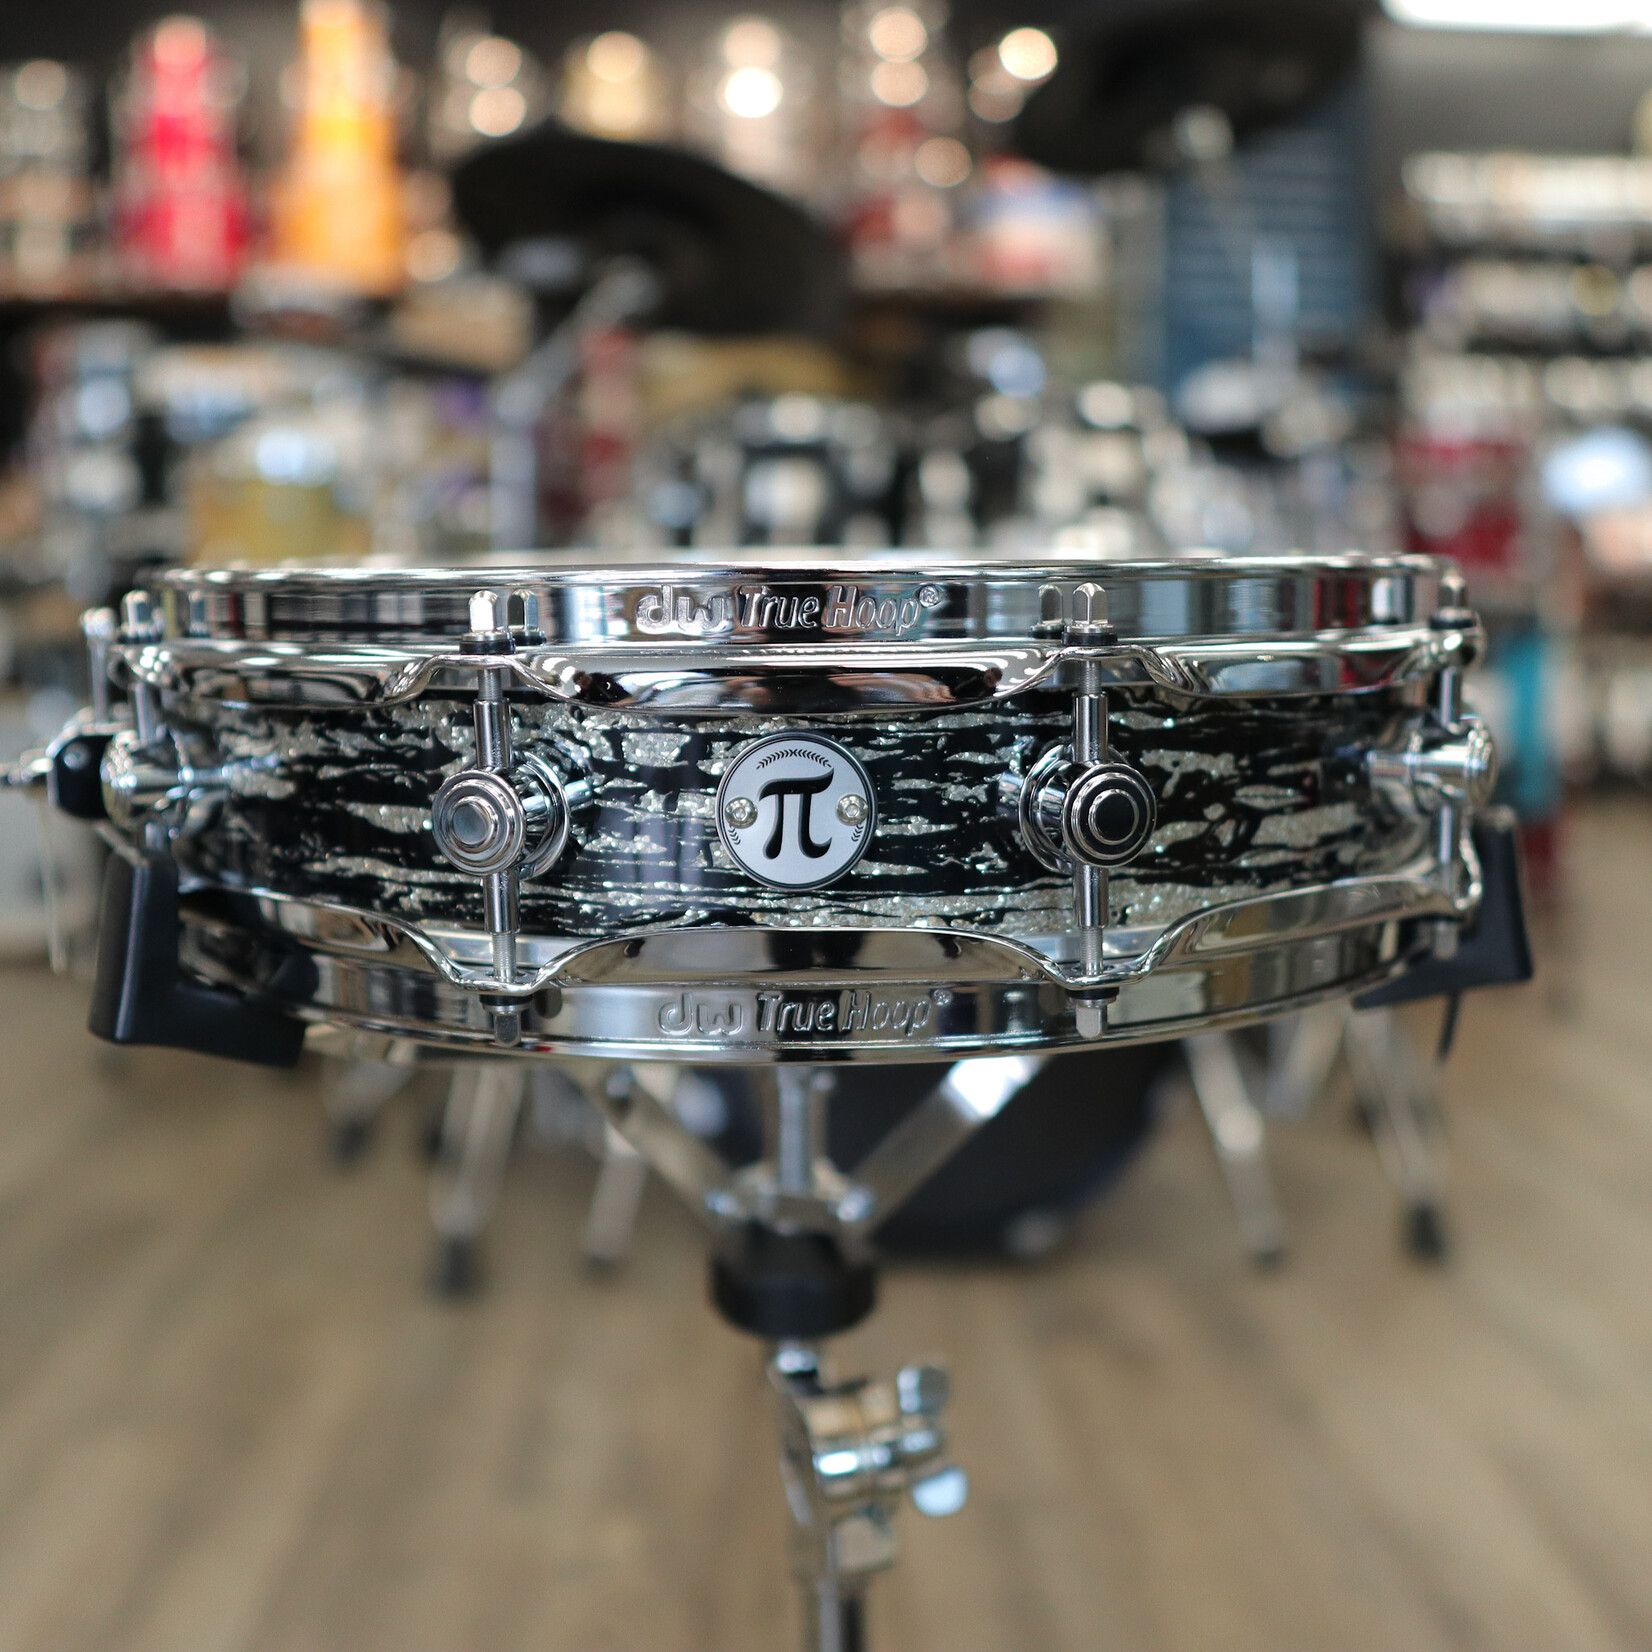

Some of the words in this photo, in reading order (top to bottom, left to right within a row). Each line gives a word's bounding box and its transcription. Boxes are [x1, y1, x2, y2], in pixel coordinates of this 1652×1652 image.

[636, 584, 733, 634] dw
[739, 585, 819, 629] True
[658, 992, 745, 1036] dw
[757, 991, 836, 1031] True
